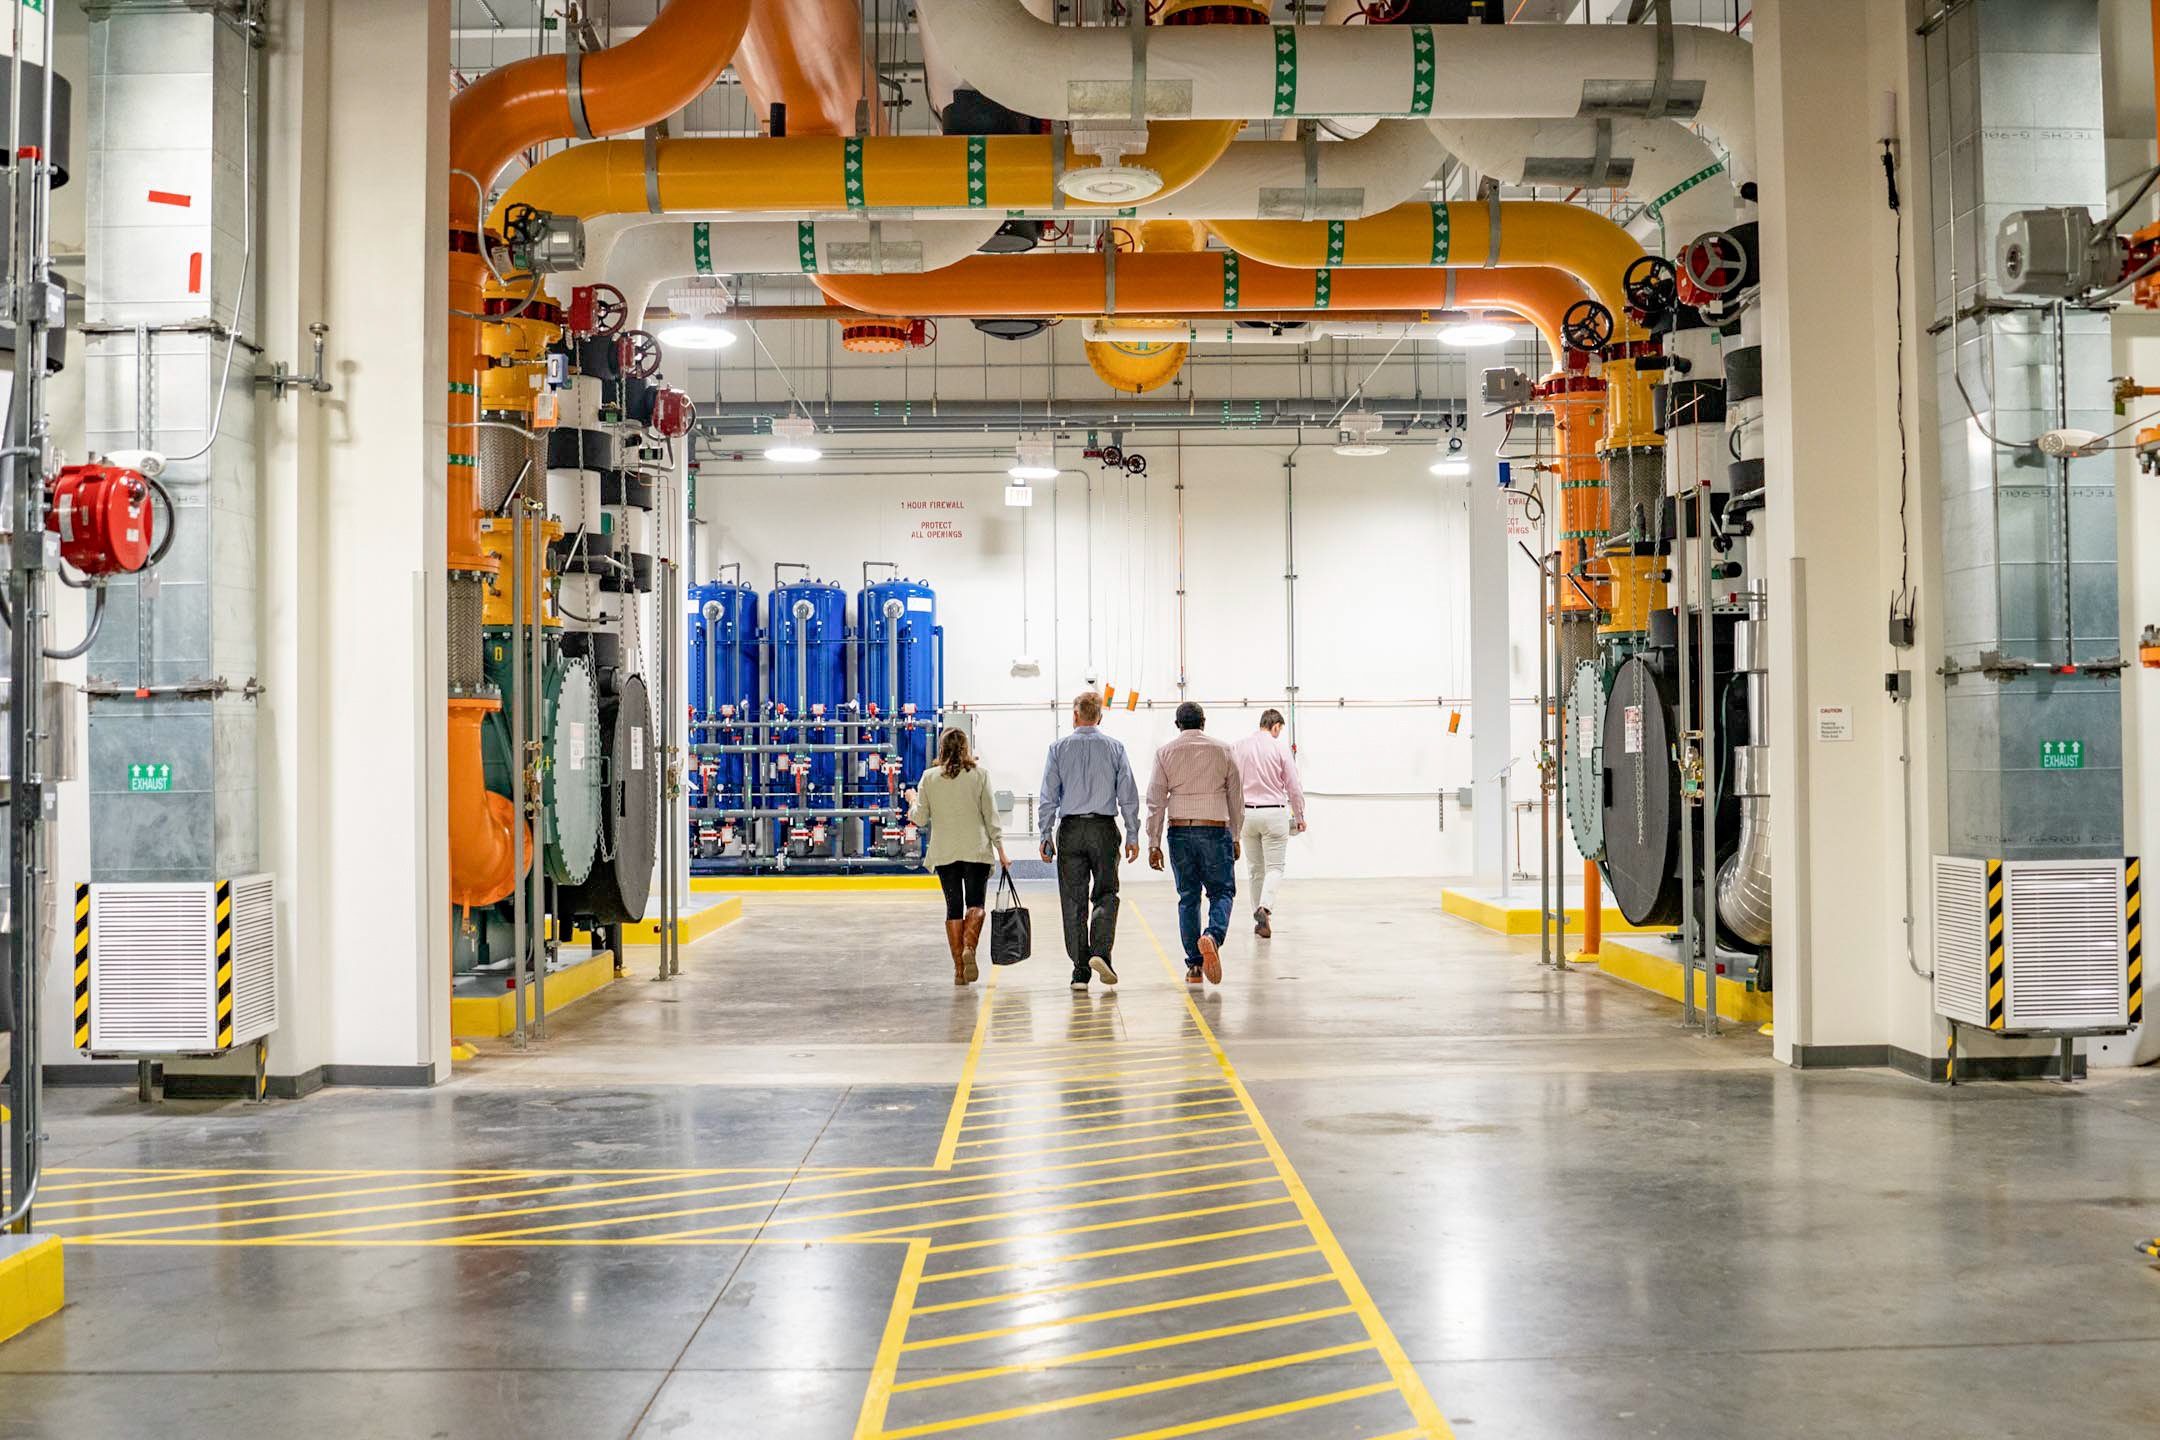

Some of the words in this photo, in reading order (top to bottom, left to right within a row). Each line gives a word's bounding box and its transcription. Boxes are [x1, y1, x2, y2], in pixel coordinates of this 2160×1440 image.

[906, 501, 927, 509] HOUR
[929, 501, 965, 509] FIREWALL
[920, 521, 952, 529] PROTECT
[911, 530, 923, 538] ALL
[926, 530, 963, 538] OPENINGS
[2044, 754, 2079, 767] EXHAUST
[132, 777, 168, 791] EXHAUST
